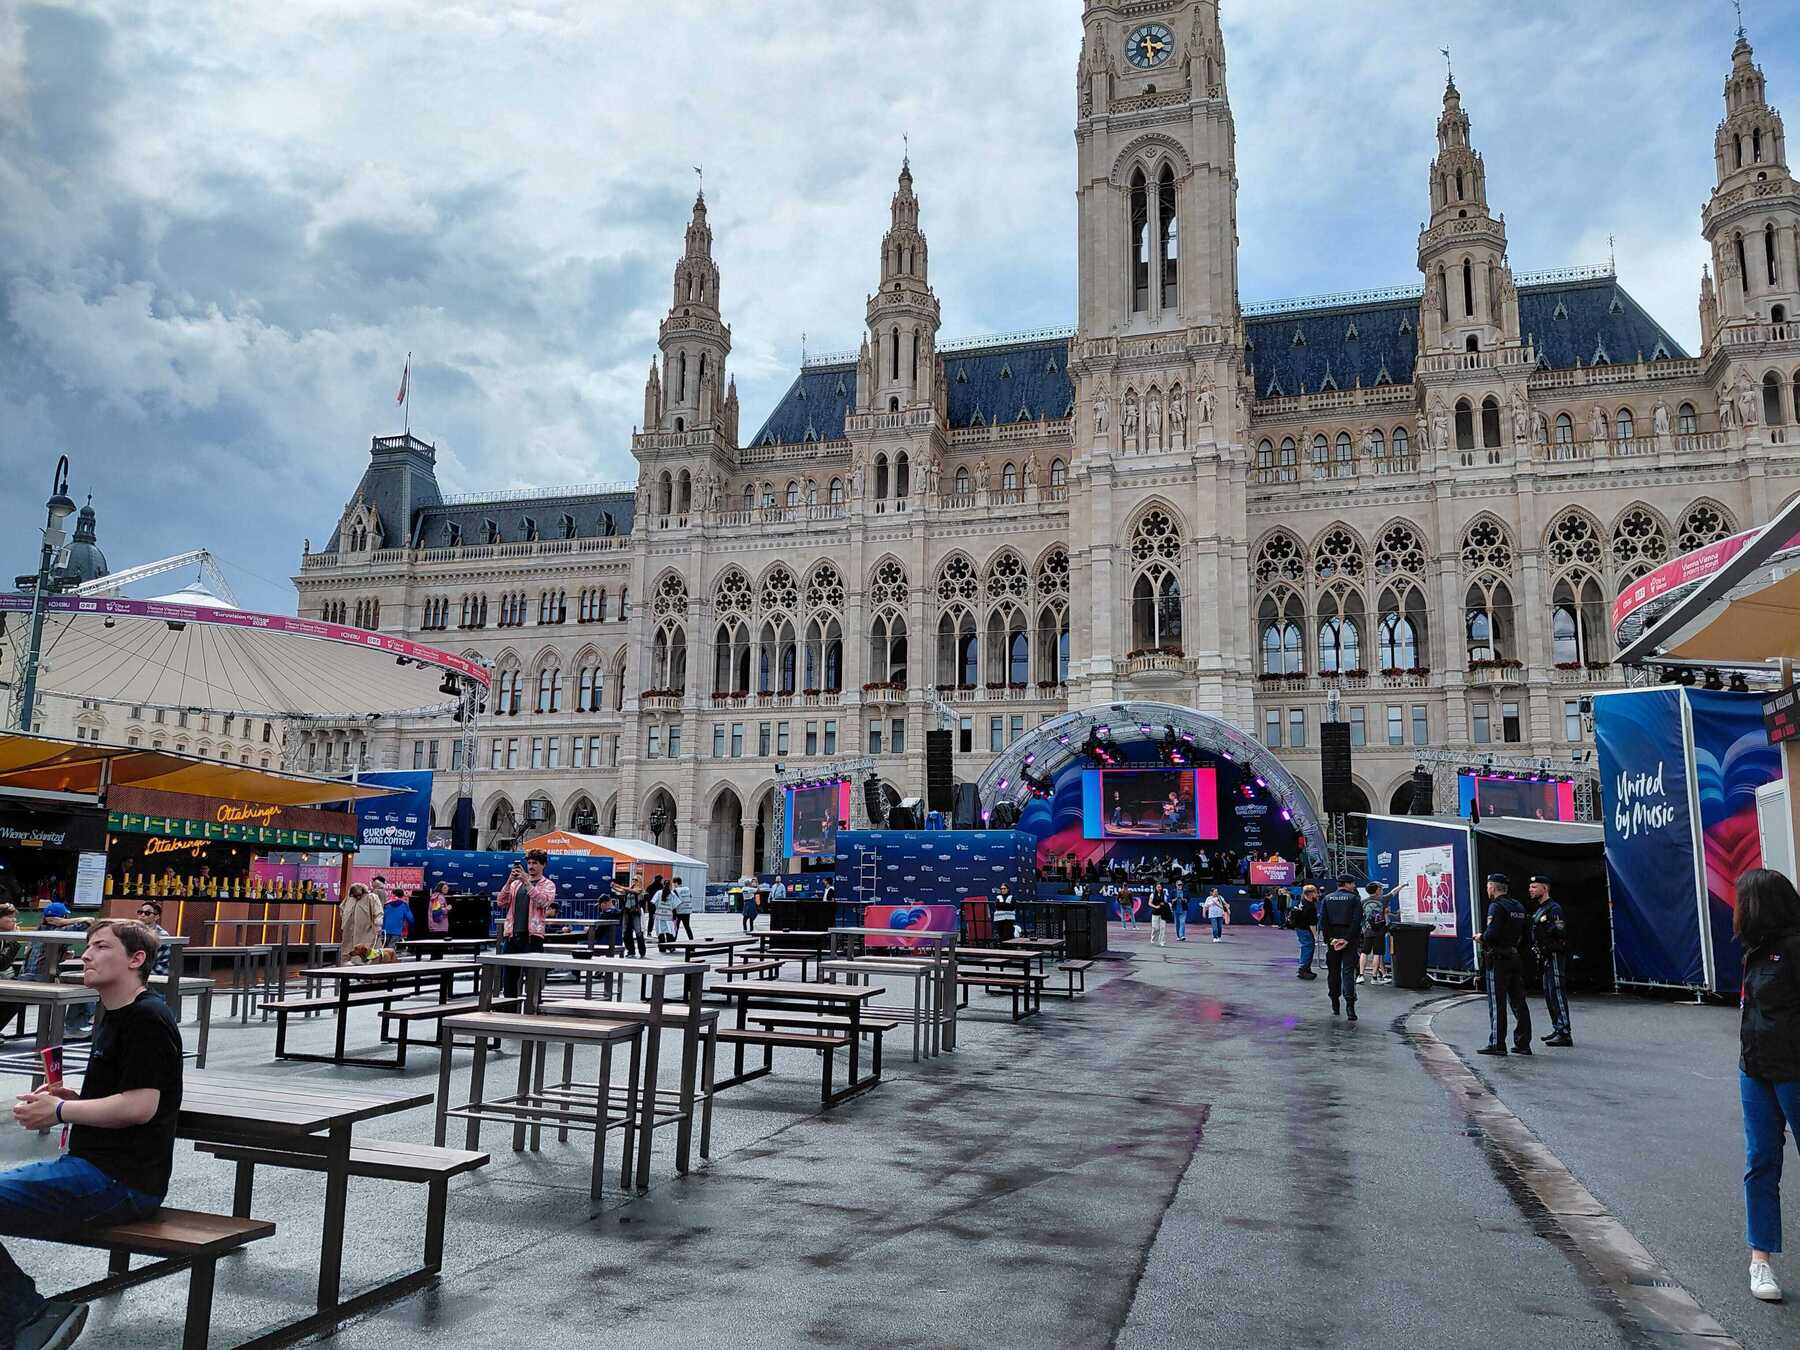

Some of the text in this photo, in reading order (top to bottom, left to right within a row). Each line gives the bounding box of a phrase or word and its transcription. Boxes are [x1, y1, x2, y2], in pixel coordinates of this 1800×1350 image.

[1682, 553, 1719, 571] Vienna Vienna
[216, 611, 270, 623] Eurovision Village
[1616, 760, 1666, 806] United
[217, 802, 282, 827] Ottakringer
[1615, 801, 1675, 840] by Music
[0, 826, 66, 842] Wiener Schnitzel
[363, 826, 416, 840] EUROVISION
[364, 836, 414, 846] SONG CONTEST
[144, 837, 211, 857] Ottakringer
[1258, 864, 1289, 872] Eurovision
[395, 880, 421, 890] Vienna
